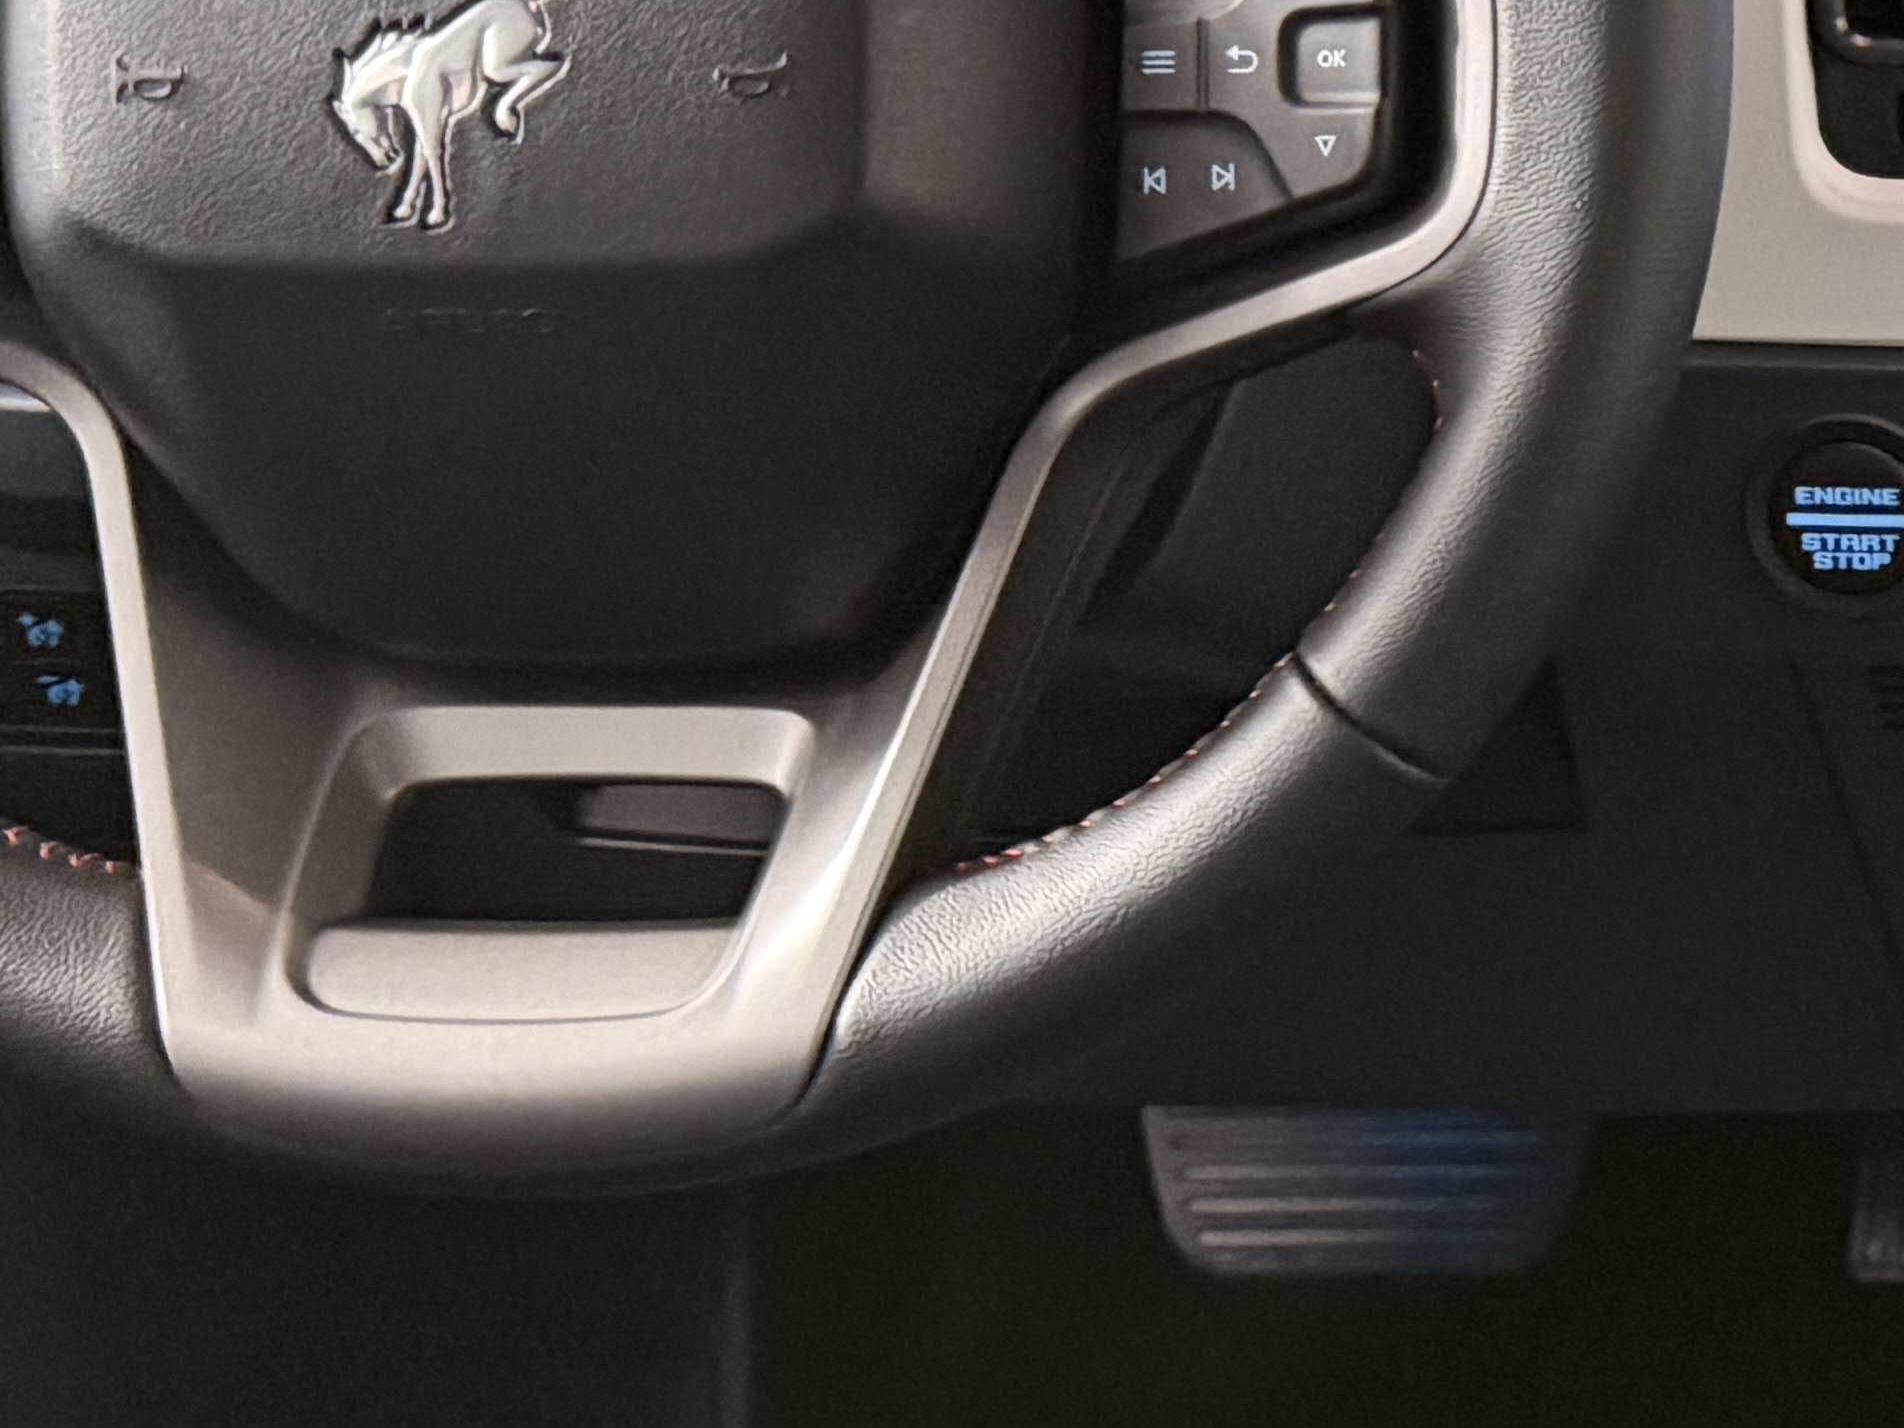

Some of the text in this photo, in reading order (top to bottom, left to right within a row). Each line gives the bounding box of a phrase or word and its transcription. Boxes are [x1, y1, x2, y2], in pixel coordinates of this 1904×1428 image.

[1316, 50, 1347, 68] OK
[1795, 486, 1900, 506] ENGINE
[1801, 533, 1899, 552] START
[1813, 552, 1892, 571] STOP
